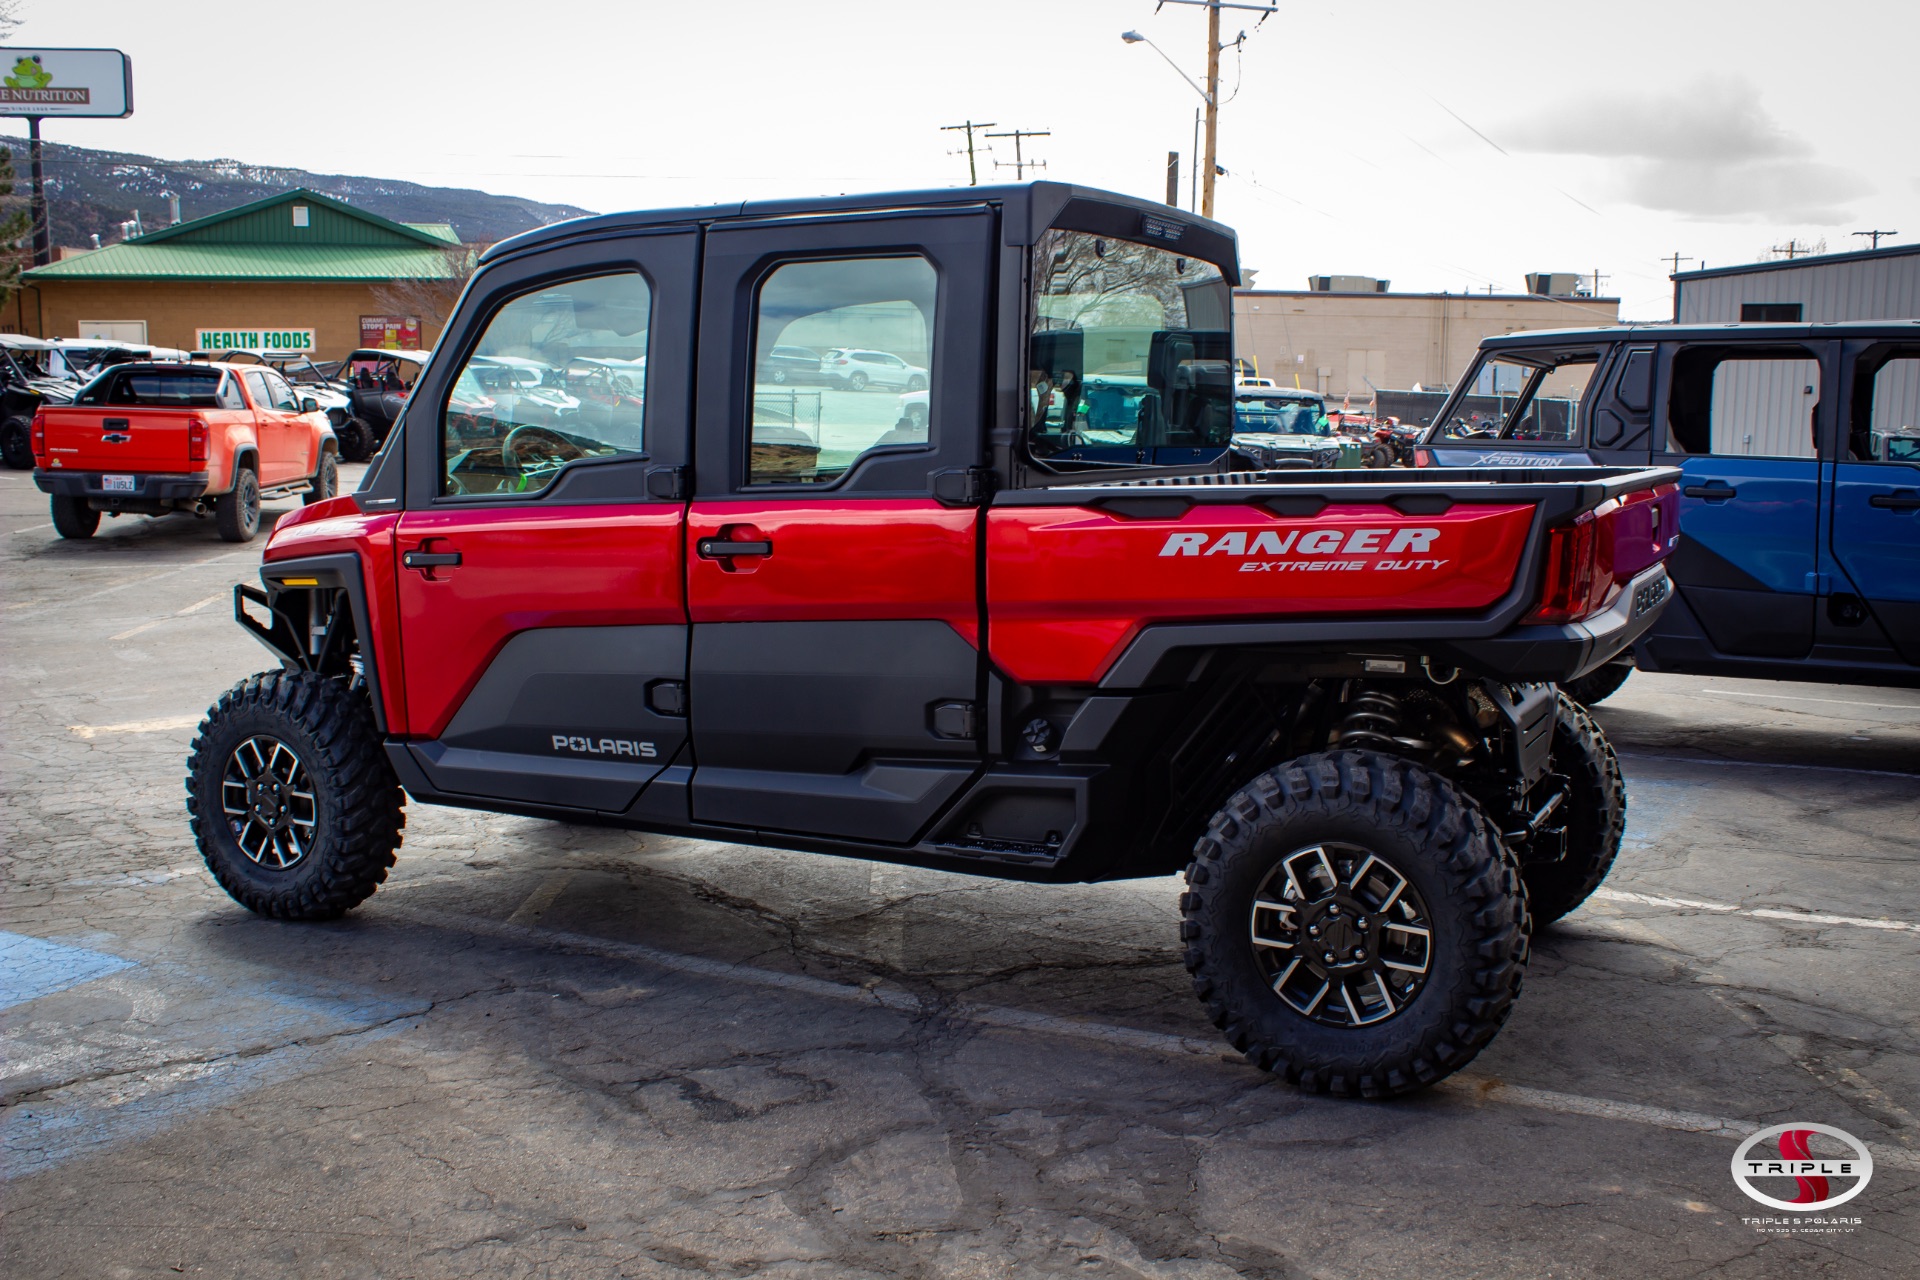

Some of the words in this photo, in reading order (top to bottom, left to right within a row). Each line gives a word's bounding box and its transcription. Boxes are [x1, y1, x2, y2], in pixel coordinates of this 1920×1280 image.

[12, 89, 86, 101] NUTRITION
[201, 332, 258, 349] HEALTH
[264, 332, 311, 349] FOODS
[1469, 452, 1563, 466] XPEDITION
[1158, 528, 1440, 557] RANGER
[1238, 561, 1367, 572] EXTREME
[1374, 559, 1449, 571] DUTY
[1635, 574, 1667, 619] POLARIS
[552, 735, 657, 757] POLARIS
